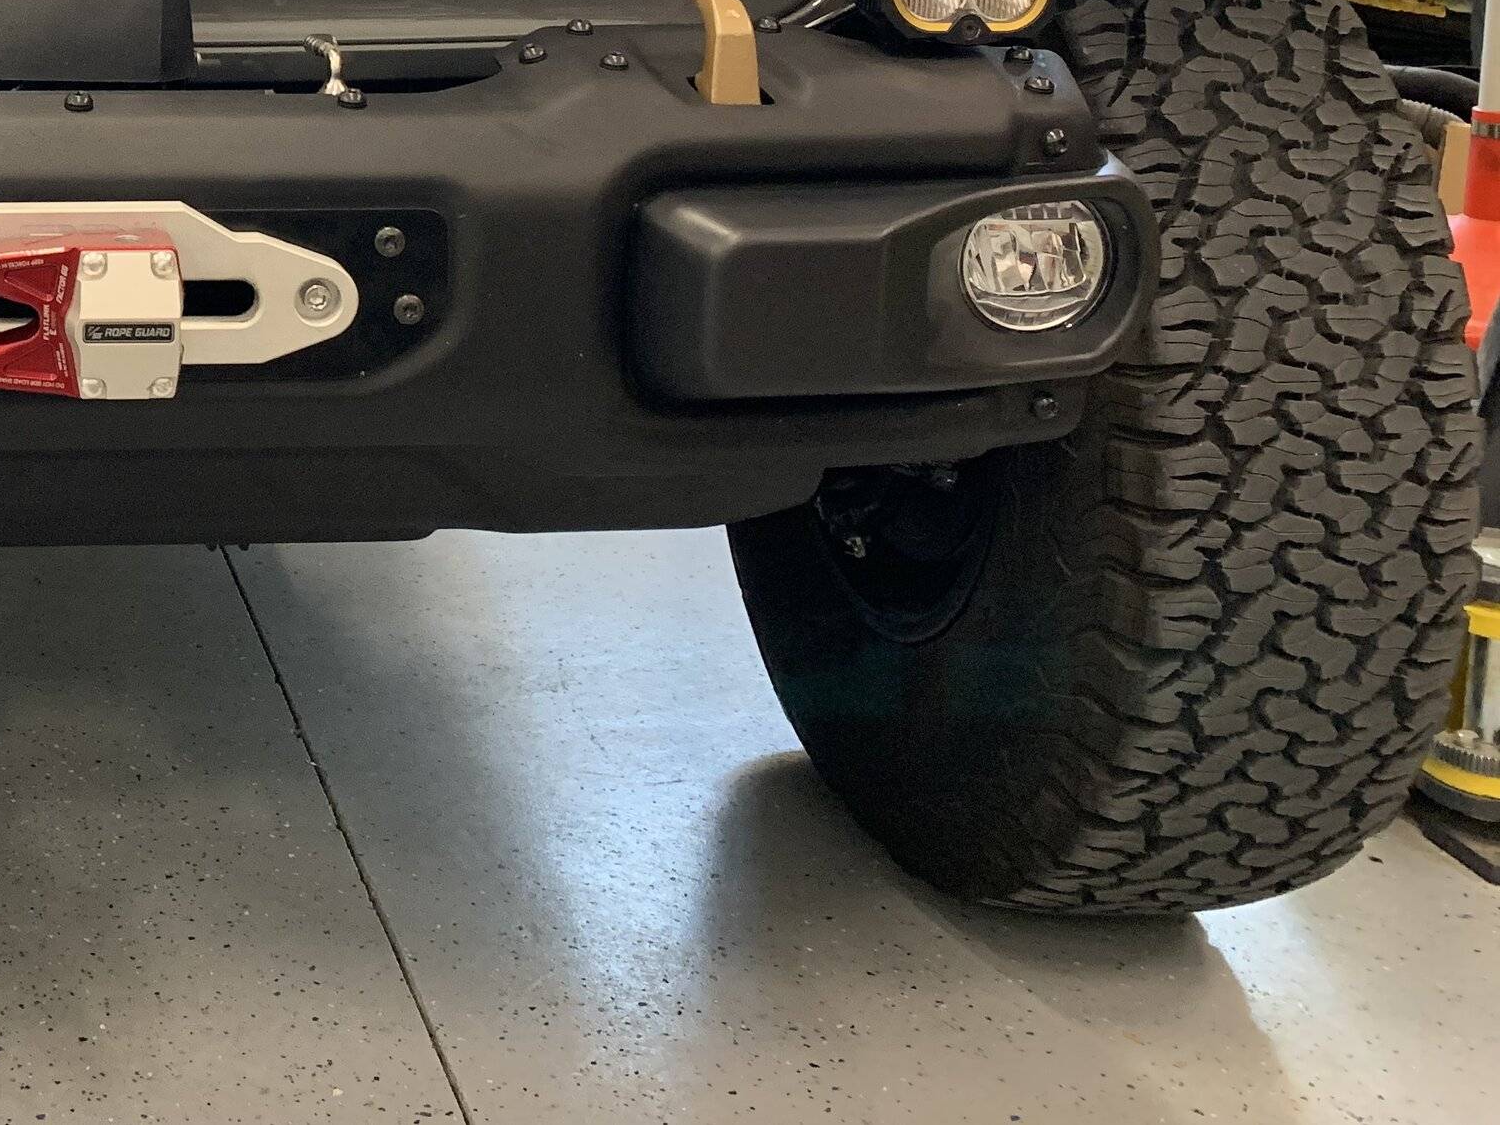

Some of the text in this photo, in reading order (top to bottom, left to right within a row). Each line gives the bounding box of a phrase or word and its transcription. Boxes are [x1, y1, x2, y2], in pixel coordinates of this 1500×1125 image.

[56, 275, 67, 304] FACTOR
[104, 327, 133, 338] ROPE
[134, 327, 171, 338] GUARD
